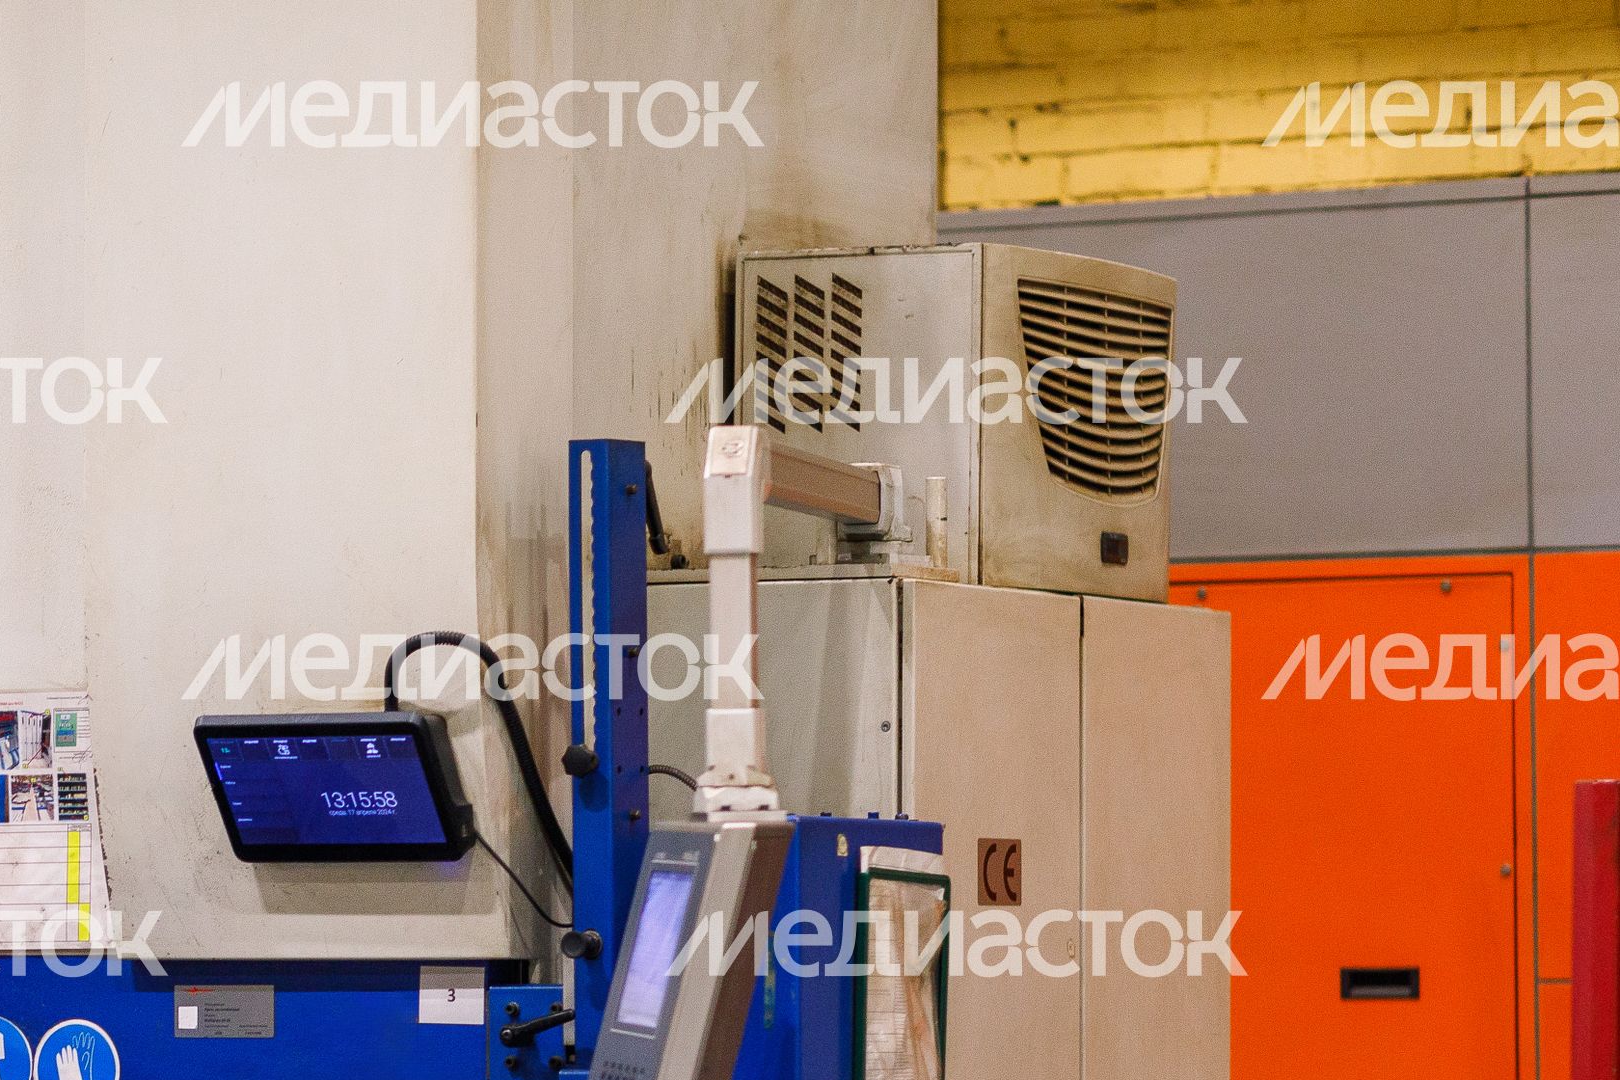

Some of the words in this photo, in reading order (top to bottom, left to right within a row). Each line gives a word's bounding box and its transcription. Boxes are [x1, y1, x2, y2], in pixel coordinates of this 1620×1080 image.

[320, 791, 398, 808] 13:15:58
[982, 842, 1017, 901] CE
[447, 988, 456, 1002] 3
